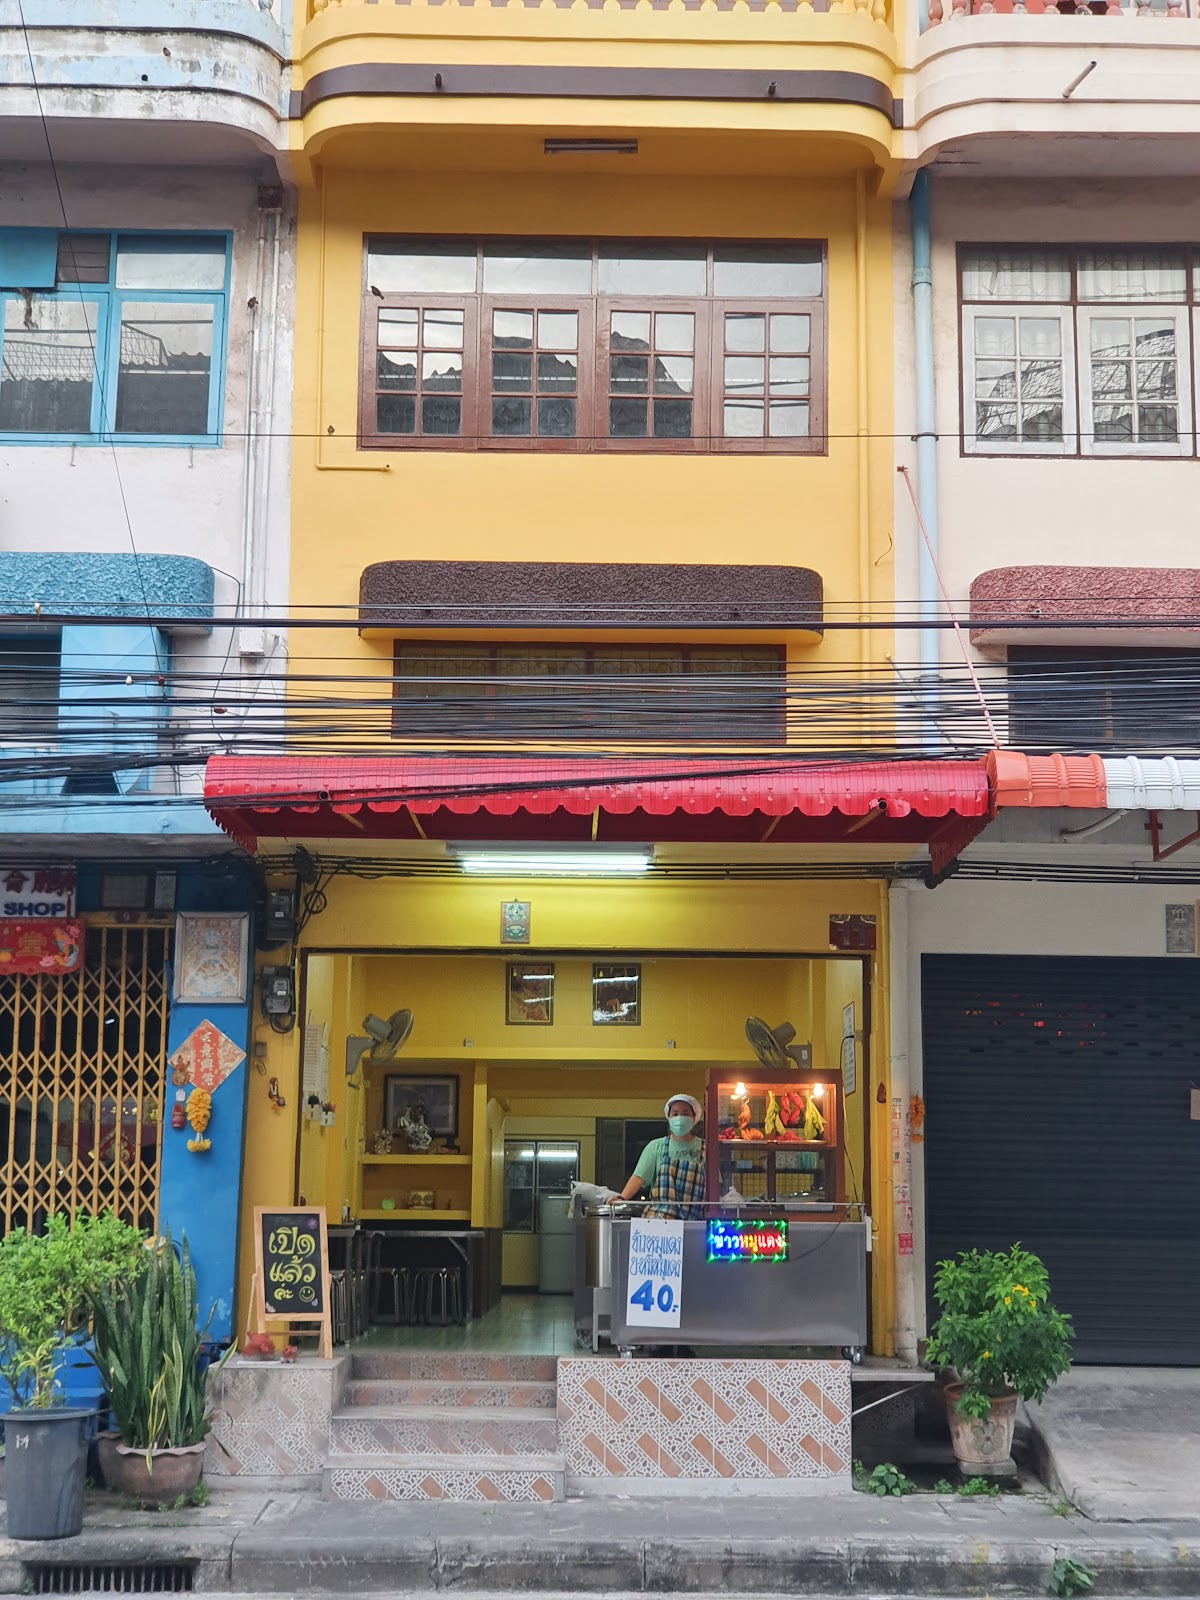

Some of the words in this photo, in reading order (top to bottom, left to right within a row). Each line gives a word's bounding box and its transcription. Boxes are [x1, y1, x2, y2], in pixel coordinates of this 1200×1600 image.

[3, 902, 65, 916] SHOP
[268, 1226, 316, 1259] เปิด
[631, 1229, 682, 1259] ข้าวหมูแดง
[713, 1226, 784, 1253] ข้าวหมูแดง
[269, 1255, 317, 1285] แล้ว
[273, 1283, 294, 1301] ค่ะ
